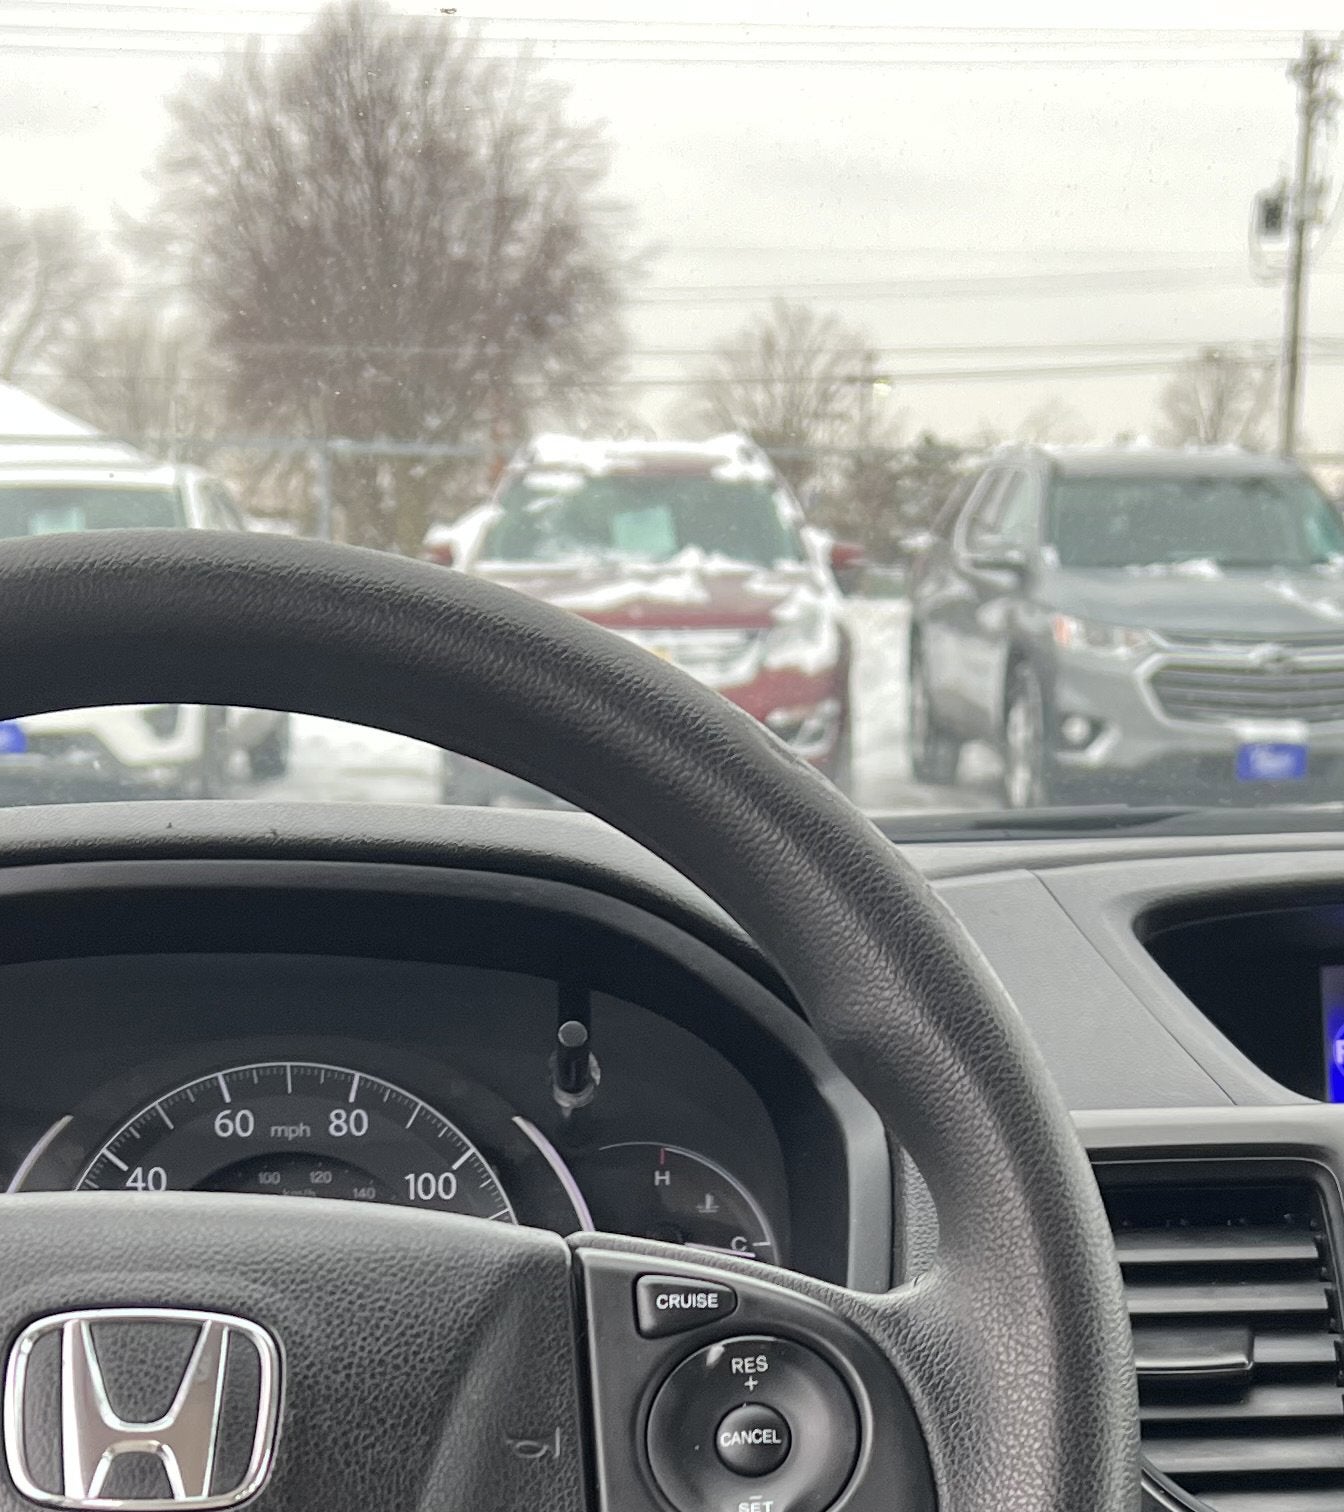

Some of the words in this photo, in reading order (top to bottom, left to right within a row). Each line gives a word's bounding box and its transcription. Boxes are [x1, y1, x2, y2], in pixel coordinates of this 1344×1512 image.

[214, 1109, 254, 1138] 60
[271, 1121, 311, 1140] mph
[328, 1109, 368, 1138] 80
[126, 1166, 167, 1192] 40
[258, 1171, 281, 1184] 100
[309, 1171, 332, 1184] 120
[405, 1172, 456, 1200] 100
[654, 1169, 671, 1187] H
[730, 1236, 748, 1252] C
[656, 1293, 719, 1310] CRUISE
[731, 1355, 768, 1374] RES
[720, 1429, 781, 1447] CANCEL
